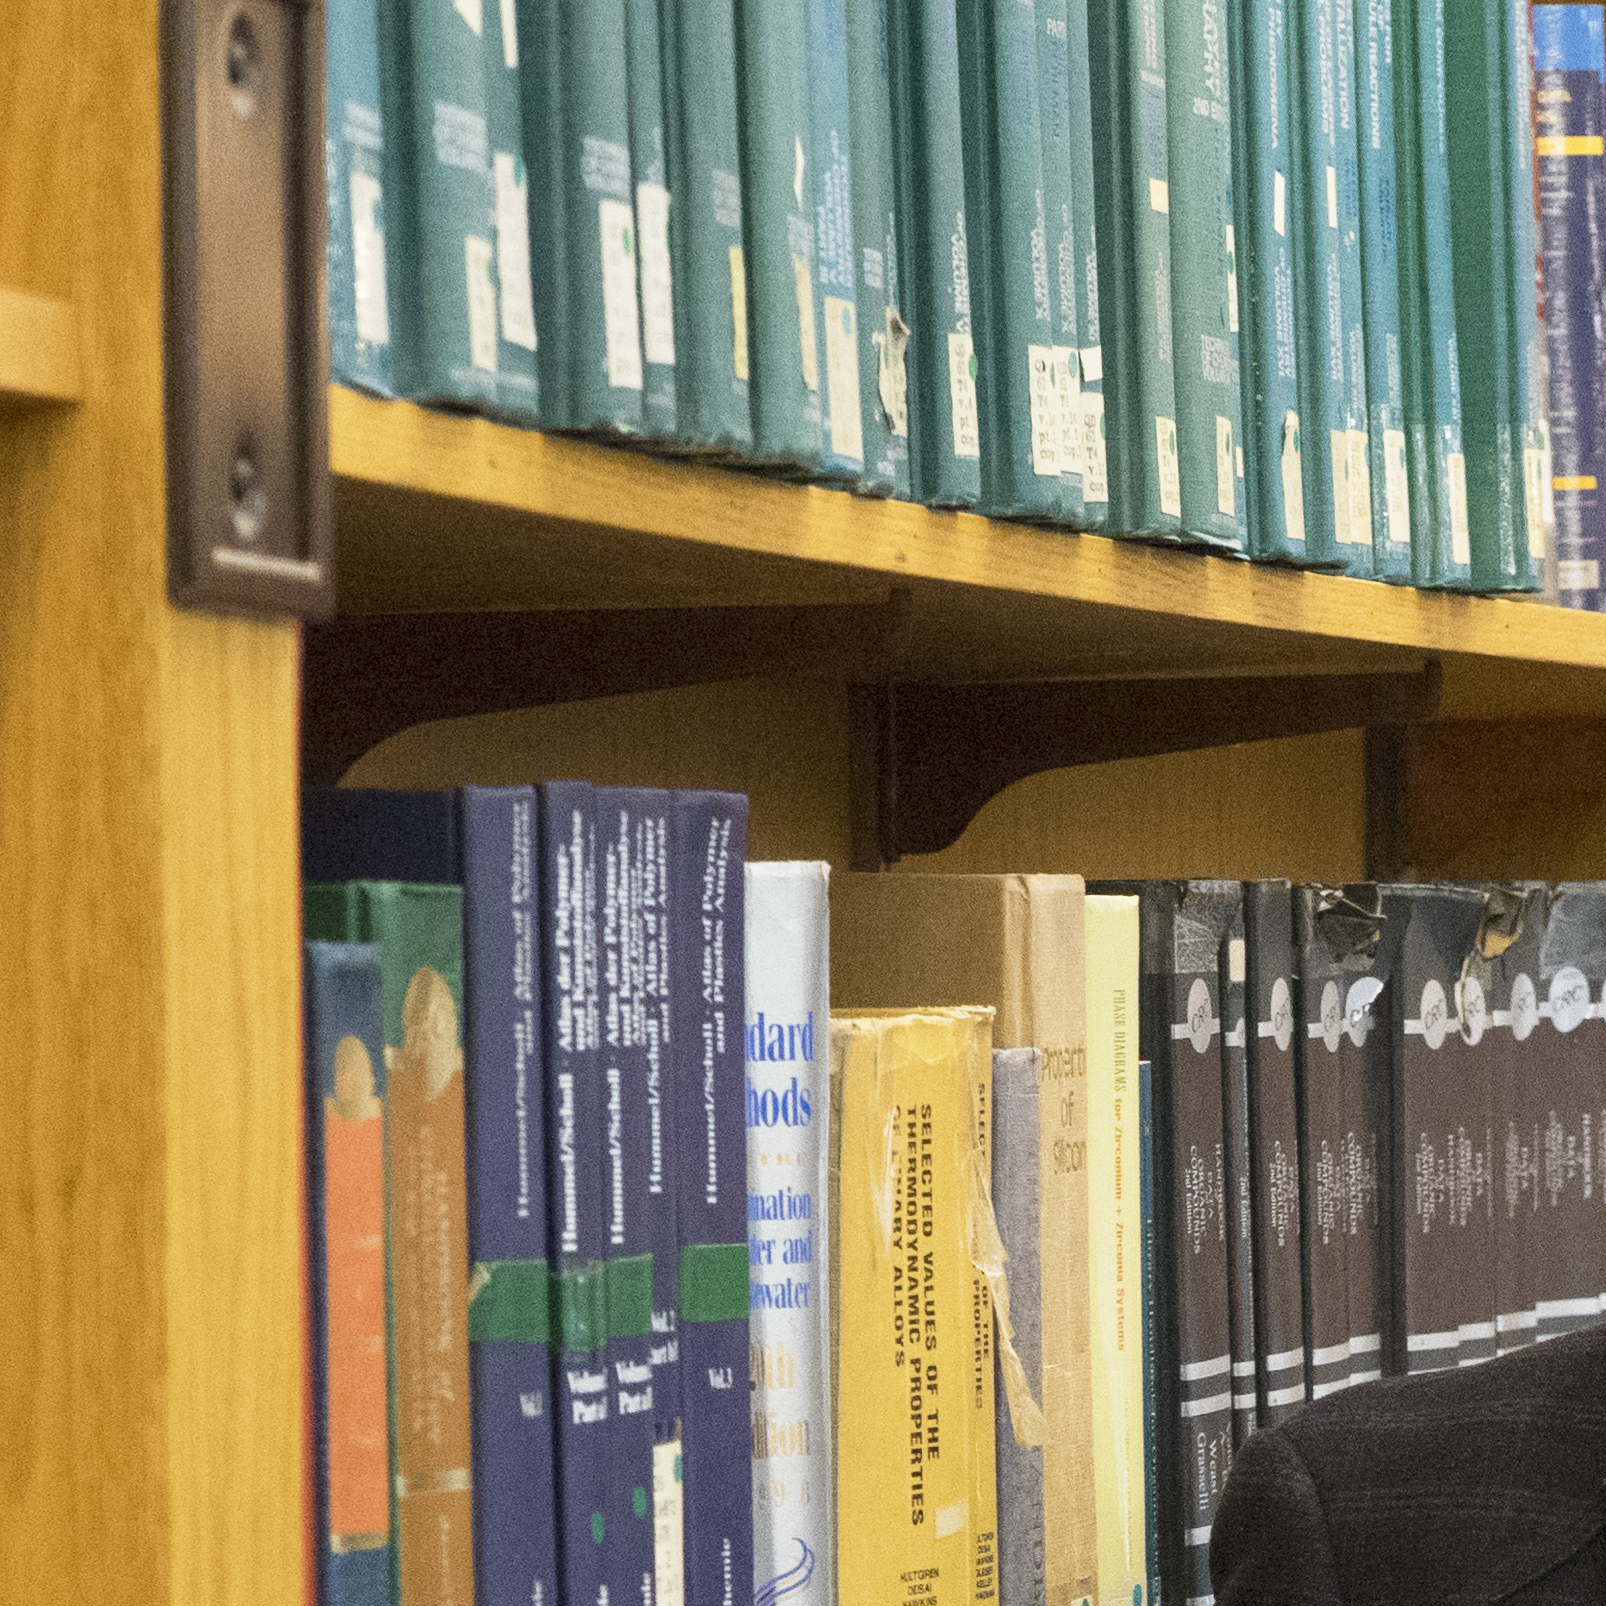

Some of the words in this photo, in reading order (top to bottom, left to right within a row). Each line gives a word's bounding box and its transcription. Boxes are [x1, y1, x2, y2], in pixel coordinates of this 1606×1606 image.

[1268, 7, 1279, 150] PHENOMENA
[643, 816, 657, 908] Polymer
[656, 816, 668, 908] Analysis
[701, 815, 721, 910] Polymer
[713, 817, 733, 913] Analysis
[644, 910, 657, 935] of
[658, 914, 669, 996] Plastics
[701, 916, 713, 939] of
[645, 940, 659, 997] Atlas
[701, 945, 714, 1003] Atlas
[712, 919, 725, 1003] Plastics
[555, 995, 573, 1051] Atlas
[603, 992, 619, 1046] Atlas
[713, 1010, 725, 1054] and
[1113, 988, 1127, 1028] PHASE
[1113, 1031, 1127, 1093] DIAGRAMS
[646, 1018, 663, 1193] Hummel/Scholl
[701, 1022, 718, 1204] Hummel/Scholl
[1061, 1090, 1075, 1129] of
[557, 1073, 579, 1252] Hummel/Scholl
[606, 1068, 625, 1245] Hummel/Scholl
[921, 1103, 934, 1239] SELECTED
[1113, 1126, 1124, 1201] Zirconium
[781, 1229, 813, 1267] and
[906, 1106, 922, 1344] THERMODYNAMIC
[1115, 1222, 1124, 1283] Zirconia
[893, 1265, 906, 1368] ALLOYS
[923, 1251, 938, 1352] VALUES
[1116, 1287, 1126, 1352] Systems
[972, 1279, 984, 1410] PROPERTIES
[926, 1365, 939, 1397] OF
[909, 1358, 925, 1527] PROPERTIES
[927, 1409, 941, 1462] THE
[1207, 1438, 1219, 1496] Weast
[900, 1566, 940, 1584] HULTGREN
[908, 1582, 932, 1597] DESAI
